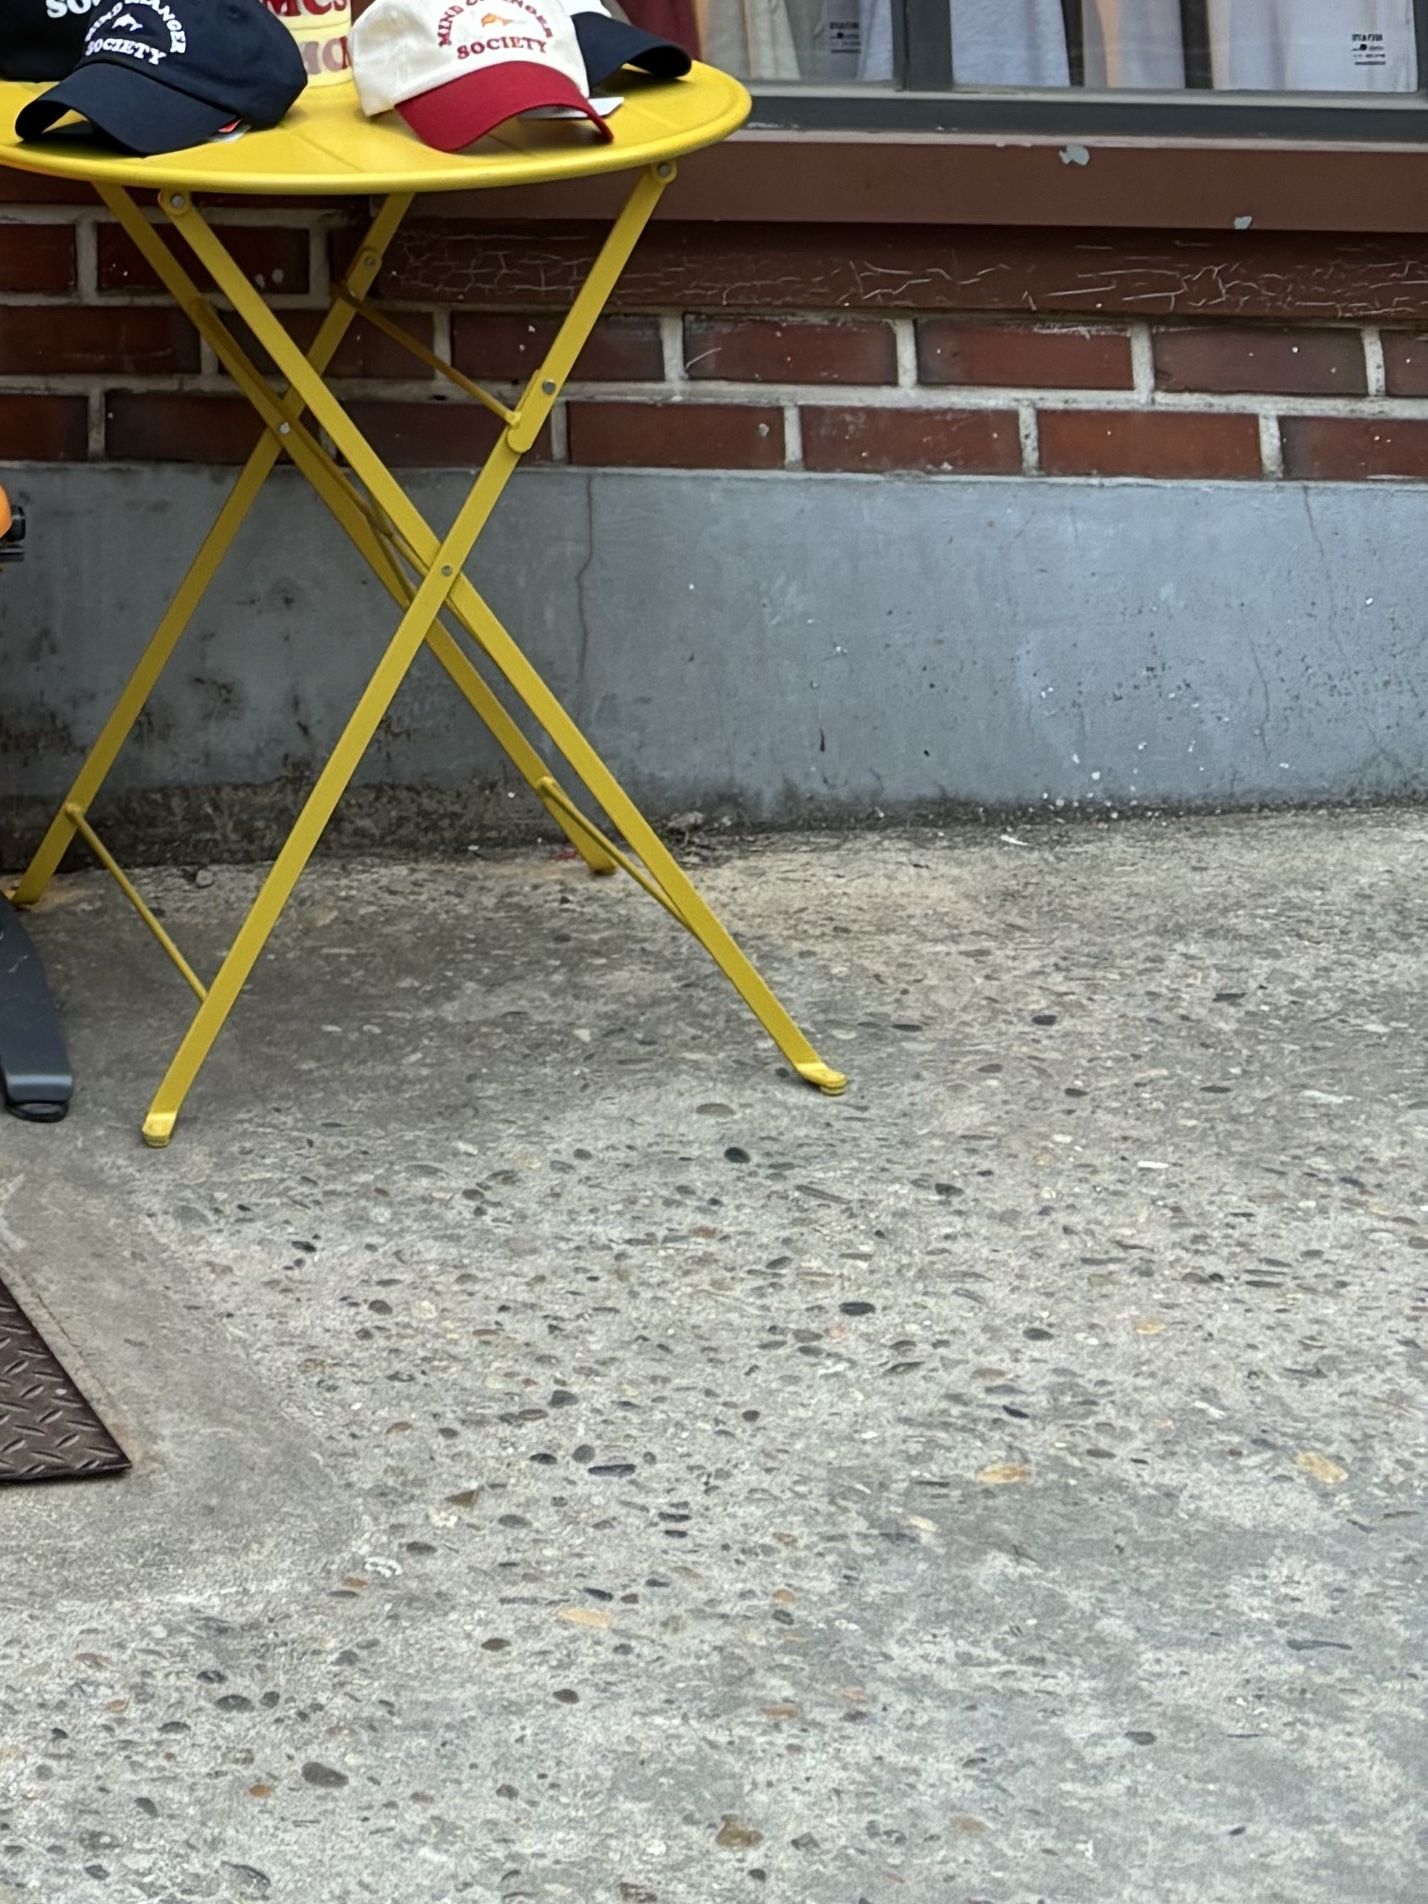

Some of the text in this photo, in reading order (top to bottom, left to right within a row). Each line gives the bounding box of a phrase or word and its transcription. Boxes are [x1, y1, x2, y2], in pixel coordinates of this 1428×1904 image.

[437, 5, 465, 48] MIND
[85, 38, 167, 66] SOCIETY
[456, 36, 548, 60] SOCIETY
